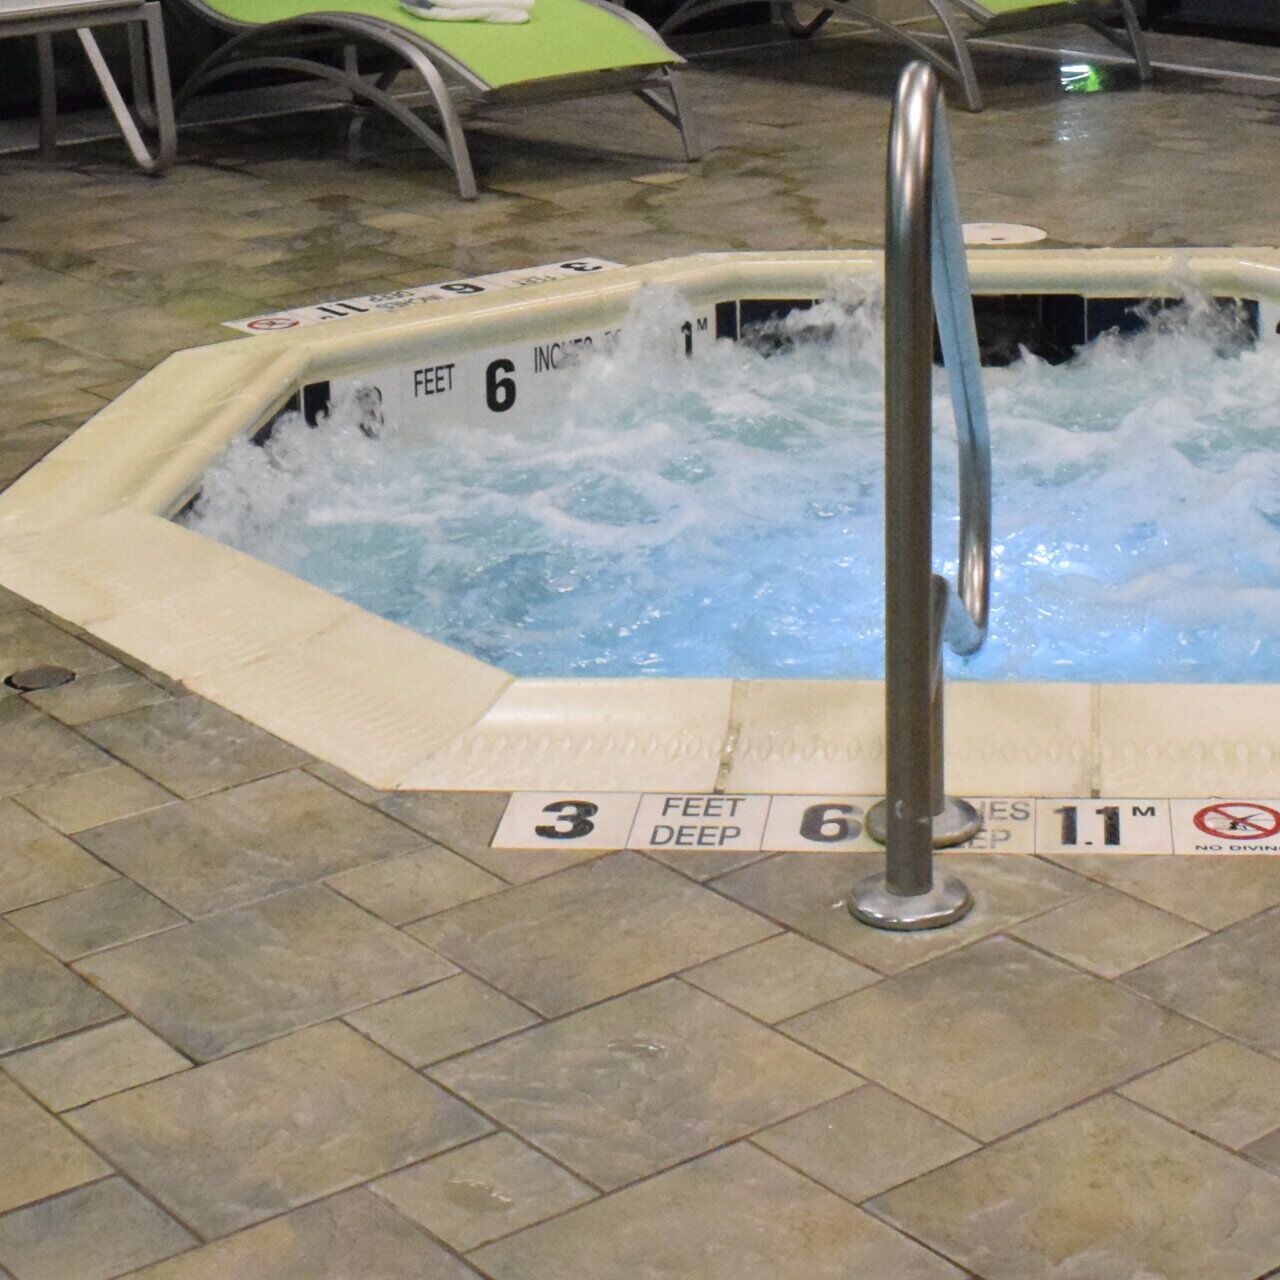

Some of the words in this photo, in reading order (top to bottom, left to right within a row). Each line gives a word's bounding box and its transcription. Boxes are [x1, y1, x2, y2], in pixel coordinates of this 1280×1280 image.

[560, 261, 603, 272] 3
[440, 282, 486, 295] 6
[414, 363, 456, 397] FEET
[486, 358, 516, 412] 6
[661, 798, 746, 817] FEET
[535, 800, 599, 840] 3
[799, 803, 865, 843] 6
[650, 825, 741, 846] DEEP
